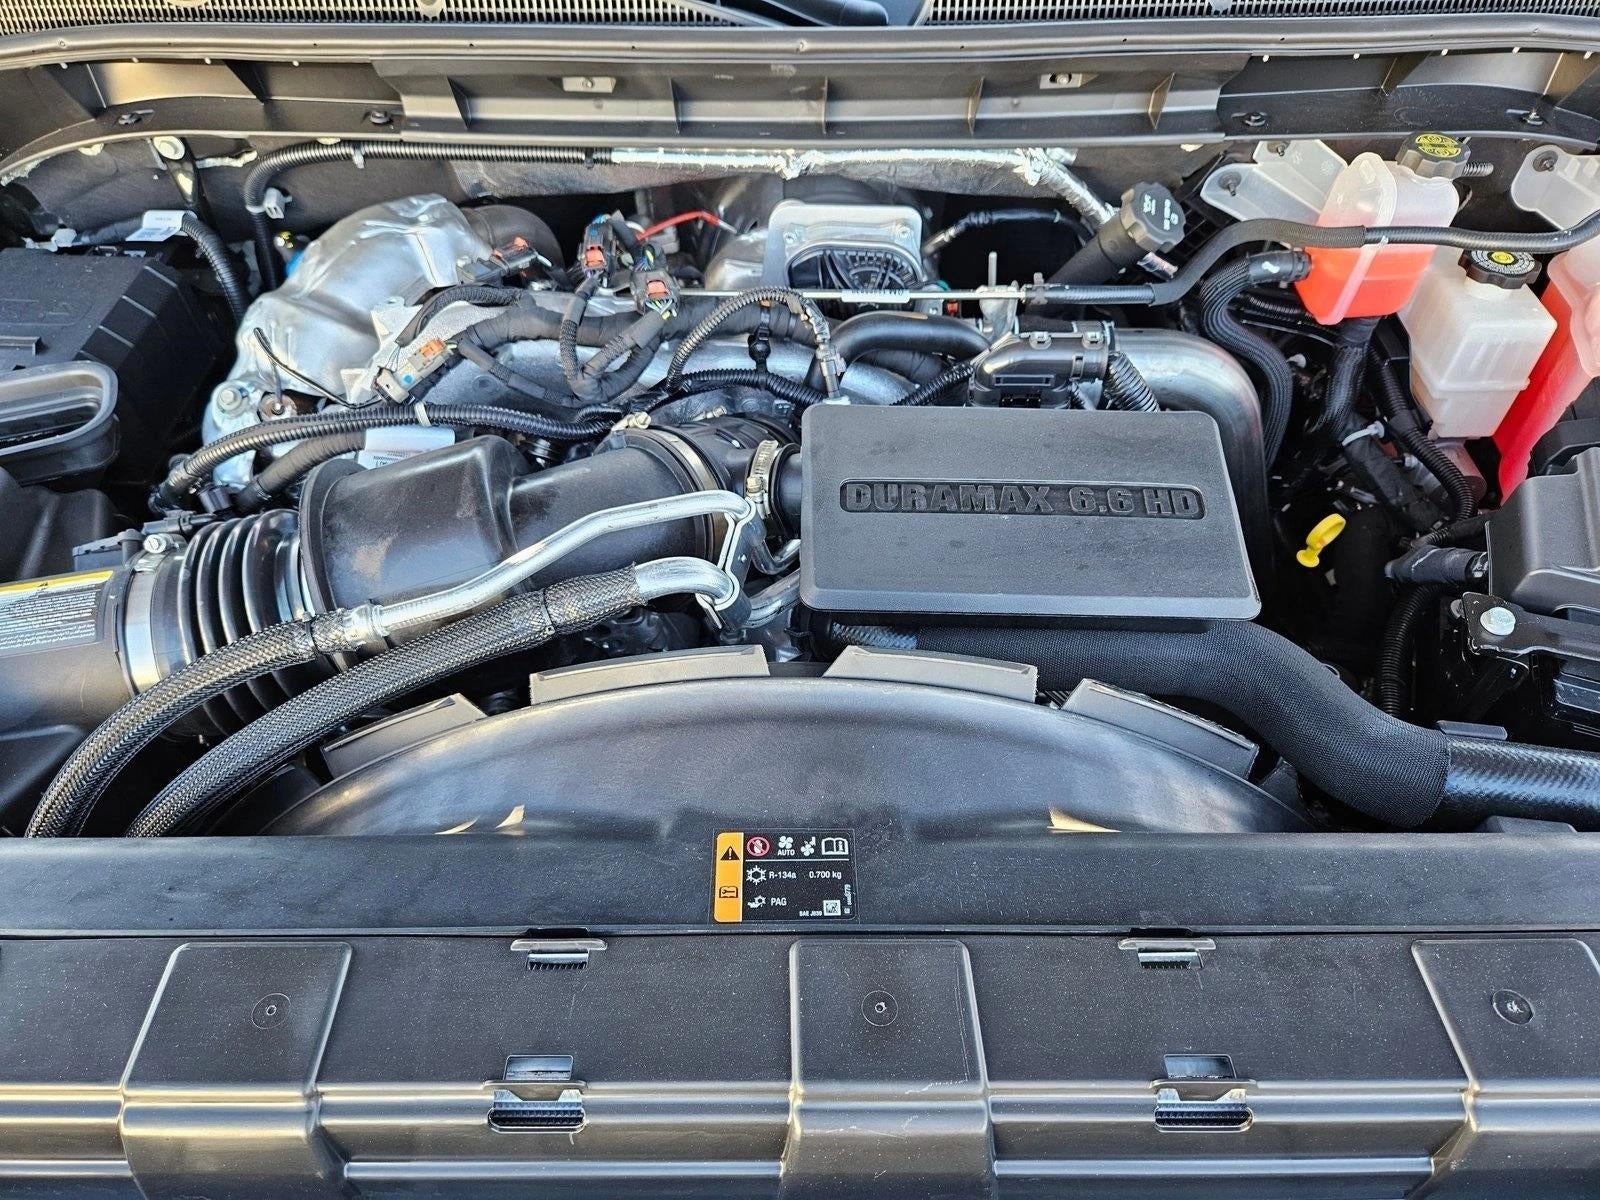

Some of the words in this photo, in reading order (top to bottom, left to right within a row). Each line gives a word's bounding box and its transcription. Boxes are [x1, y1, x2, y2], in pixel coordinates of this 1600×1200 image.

[845, 483, 1054, 512] DURAMAX
[1068, 487, 1134, 514] 6.6
[1143, 488, 1200, 517] HD
[769, 871, 797, 879] R-134a
[832, 871, 842, 879] kg
[771, 898, 787, 906] PAG
